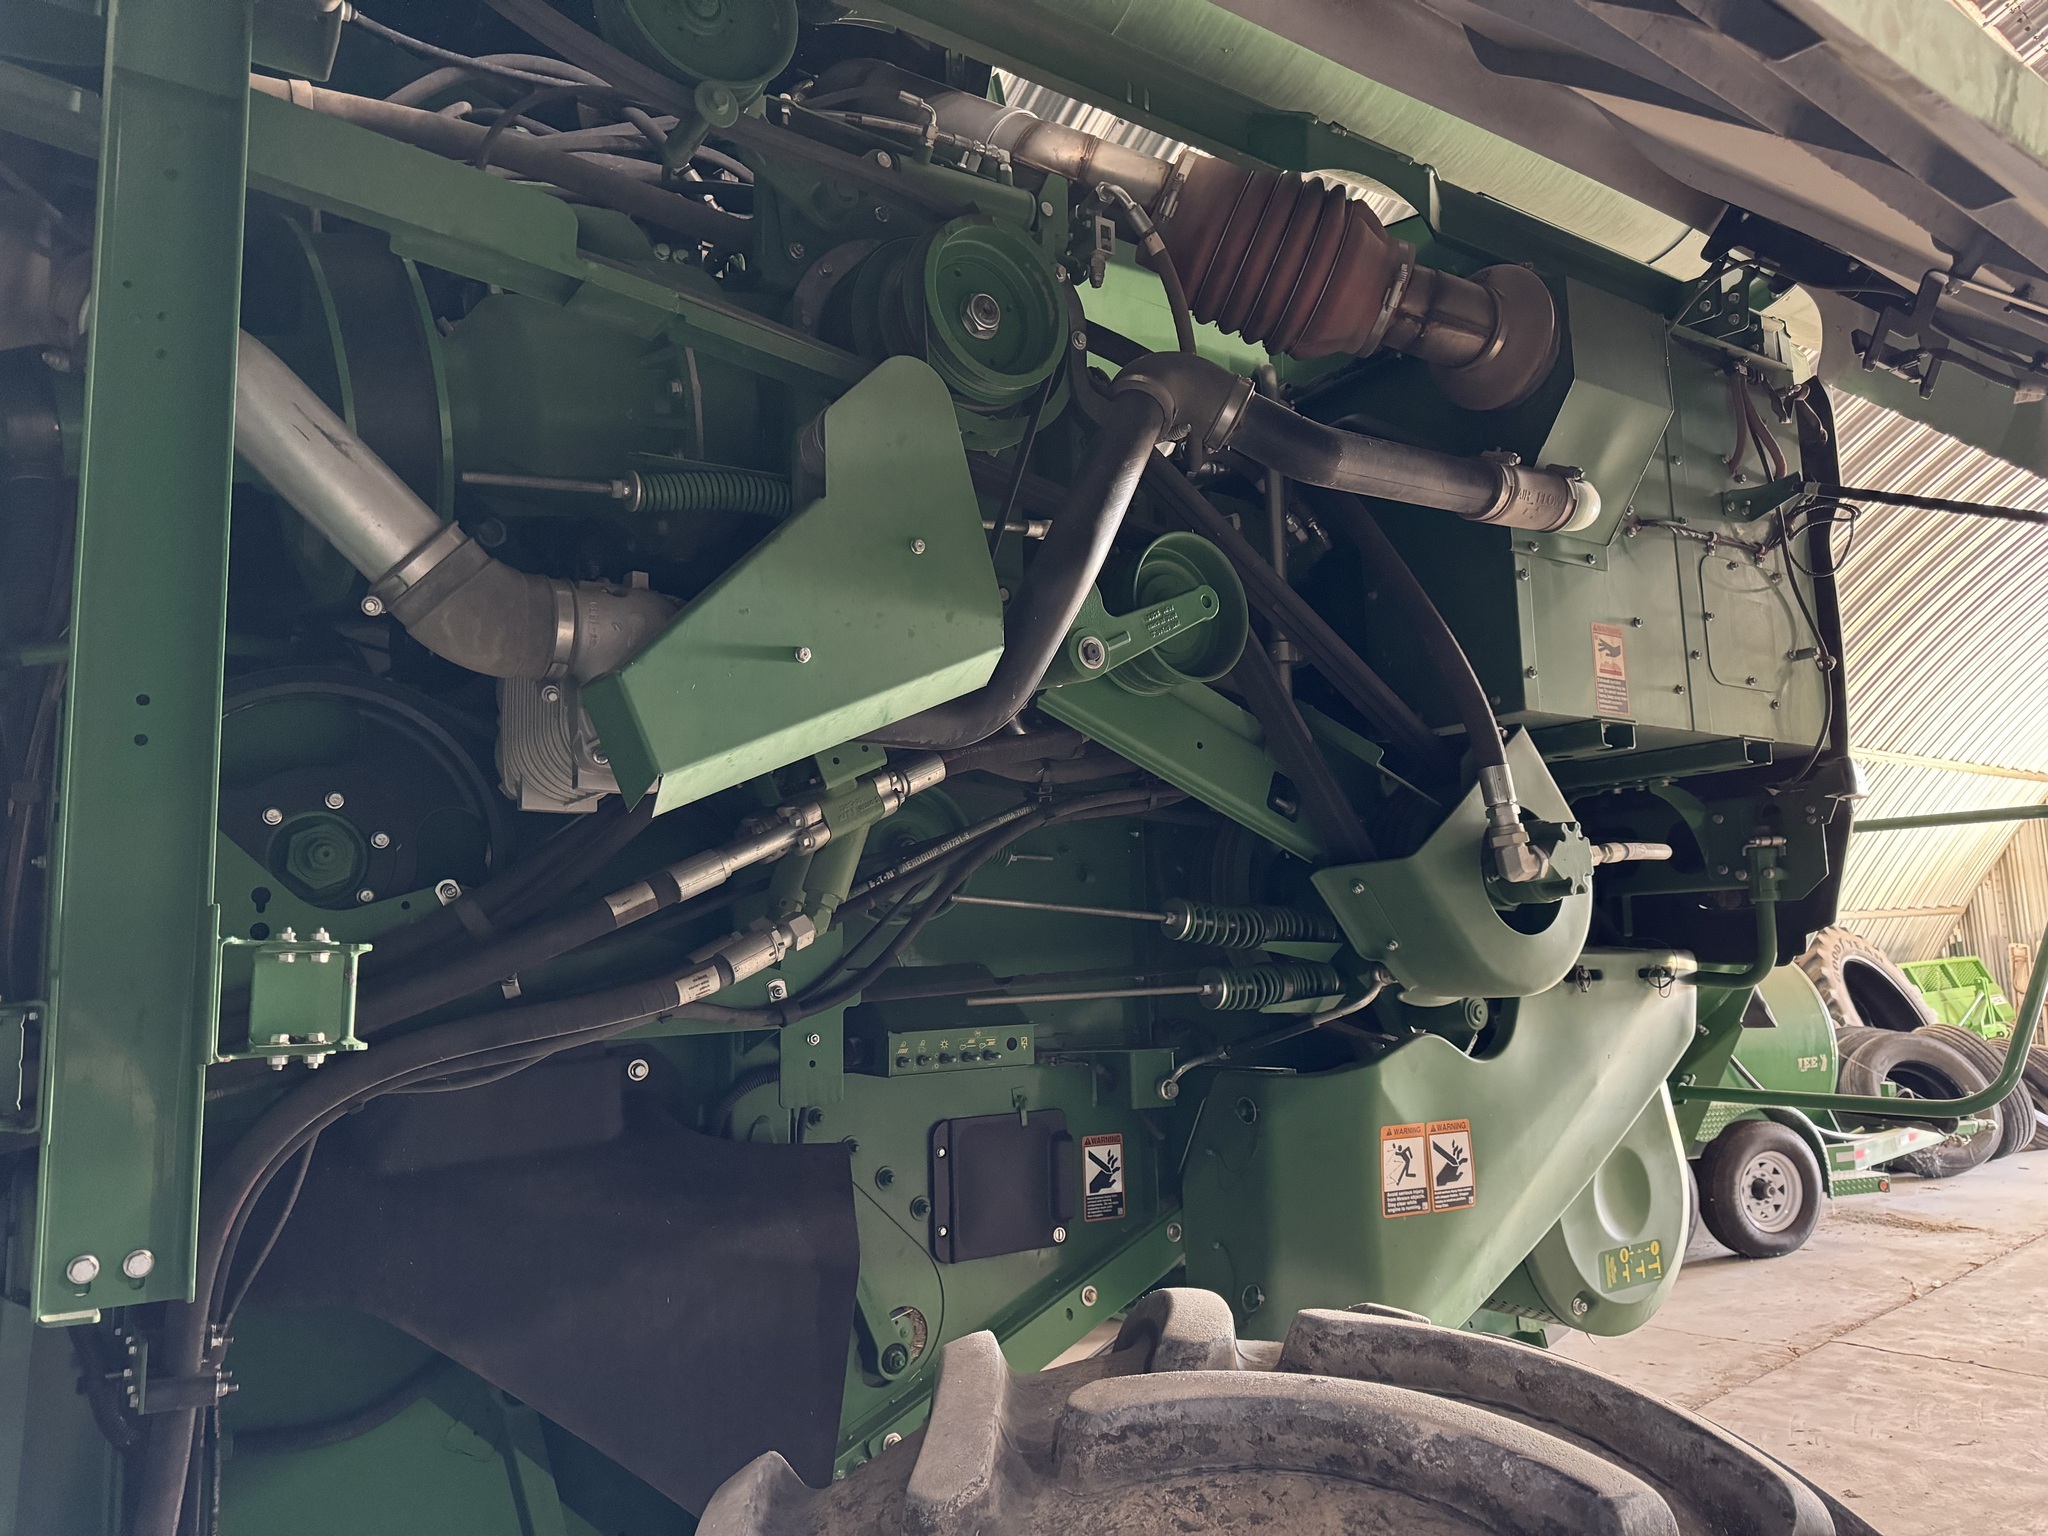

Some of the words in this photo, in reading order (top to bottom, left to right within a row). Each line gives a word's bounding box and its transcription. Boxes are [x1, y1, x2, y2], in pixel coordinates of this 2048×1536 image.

[902, 848, 939, 873] AEROQUIP
[1394, 1126, 1421, 1135] WARNING
[1437, 1121, 1467, 1132] WARNING
[1091, 1135, 1121, 1145] WARNING
